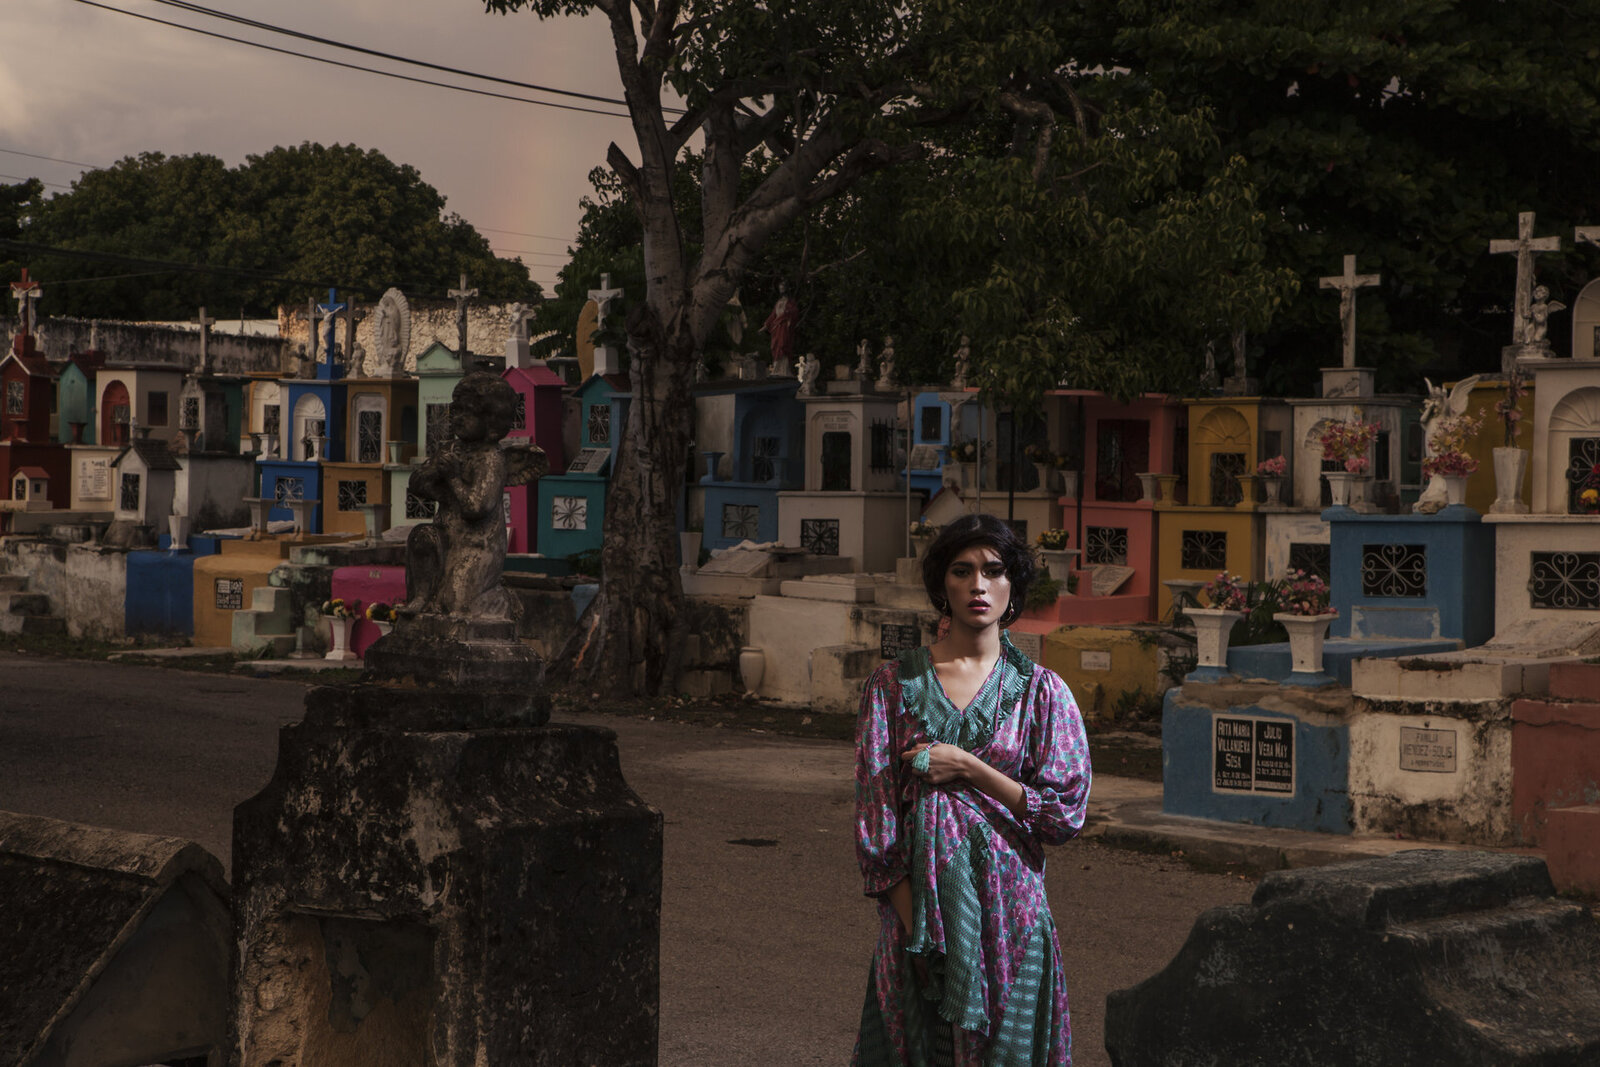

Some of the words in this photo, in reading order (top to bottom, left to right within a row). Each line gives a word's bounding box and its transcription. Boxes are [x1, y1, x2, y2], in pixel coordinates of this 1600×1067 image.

[1218, 721, 1231, 736] RITA
[1264, 724, 1282, 740] JULIO
[1217, 737, 1251, 753] VILLANUEVA
[1258, 741, 1273, 757] VERA
[1275, 742, 1288, 758] MAY
[1225, 753, 1241, 768] SOSA
